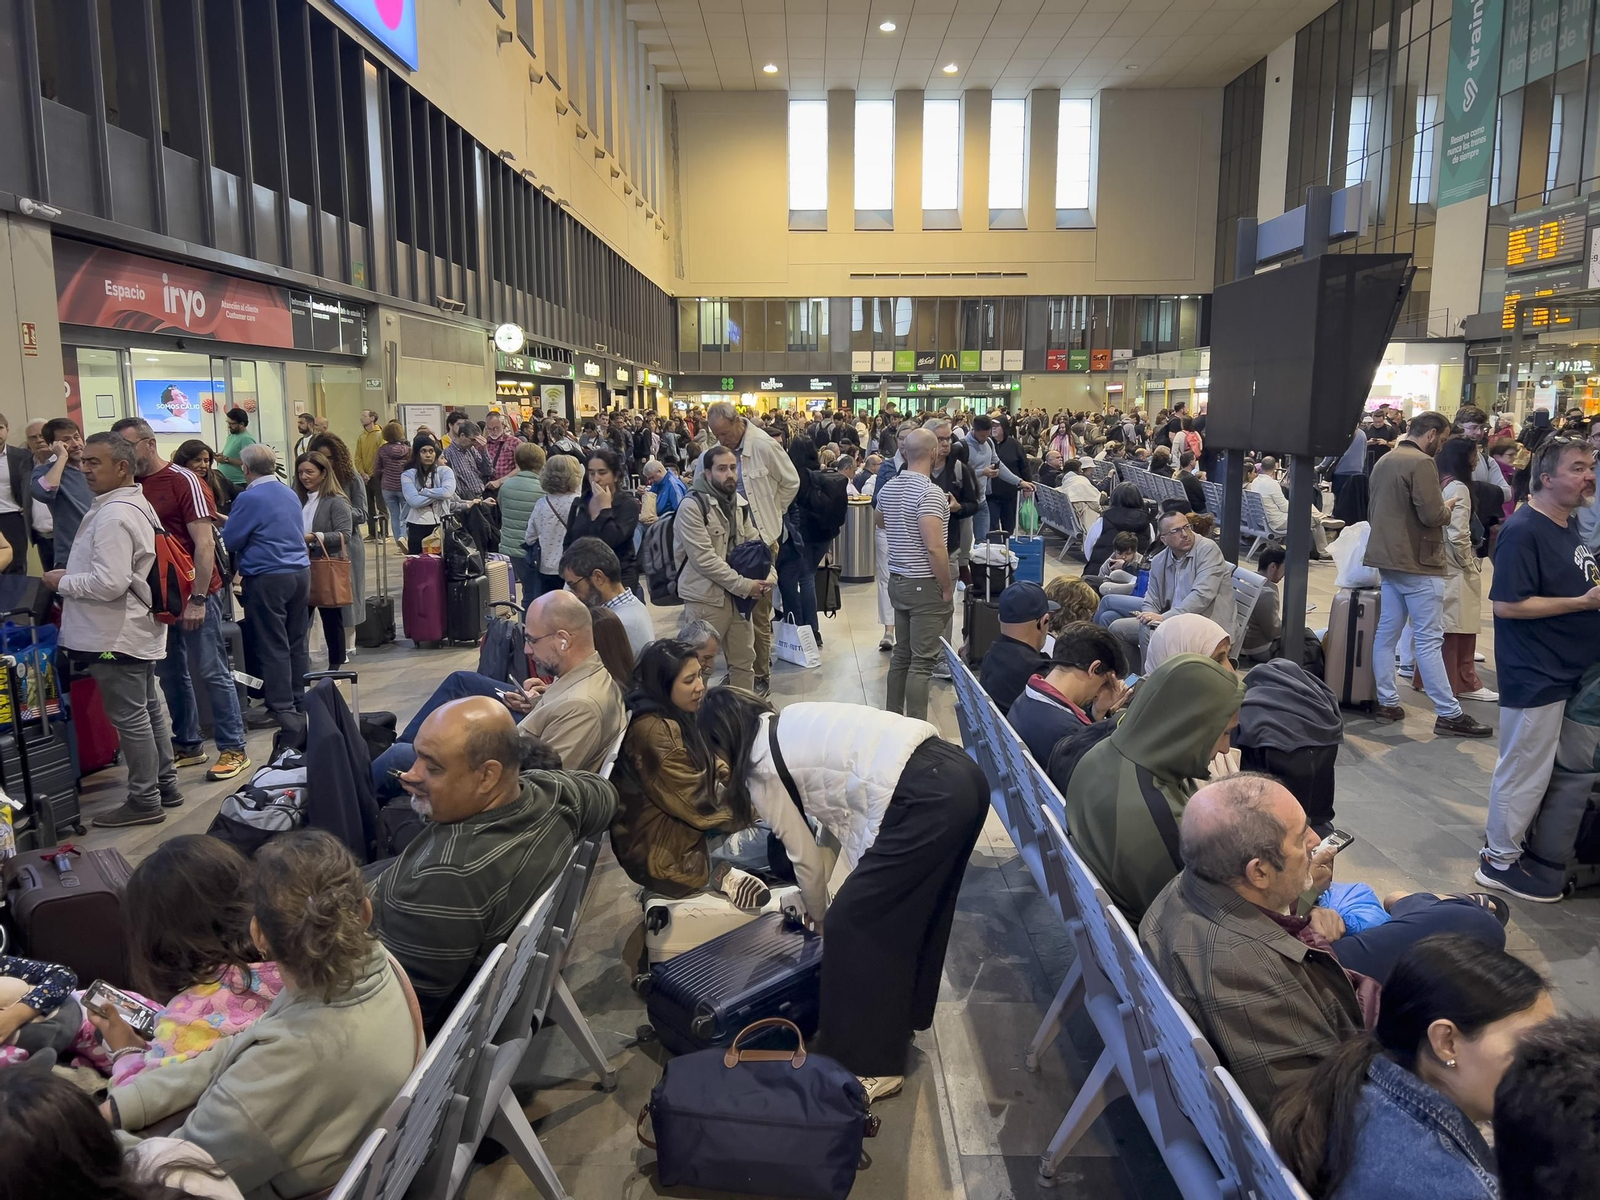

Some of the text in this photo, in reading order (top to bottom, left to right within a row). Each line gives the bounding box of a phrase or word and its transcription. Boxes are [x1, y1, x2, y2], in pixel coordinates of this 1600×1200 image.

[1467, 0, 1483, 70] train
[1447, 135, 1487, 157] nunca los trenes
[1450, 126, 1485, 146] Reserva como
[1452, 148, 1480, 164] de siempre
[104, 279, 146, 301] Espacio
[162, 273, 206, 327] iryo
[221, 300, 240, 311] Atención
[244, 304, 259, 314] cliente
[225, 310, 256, 322] Customer care
